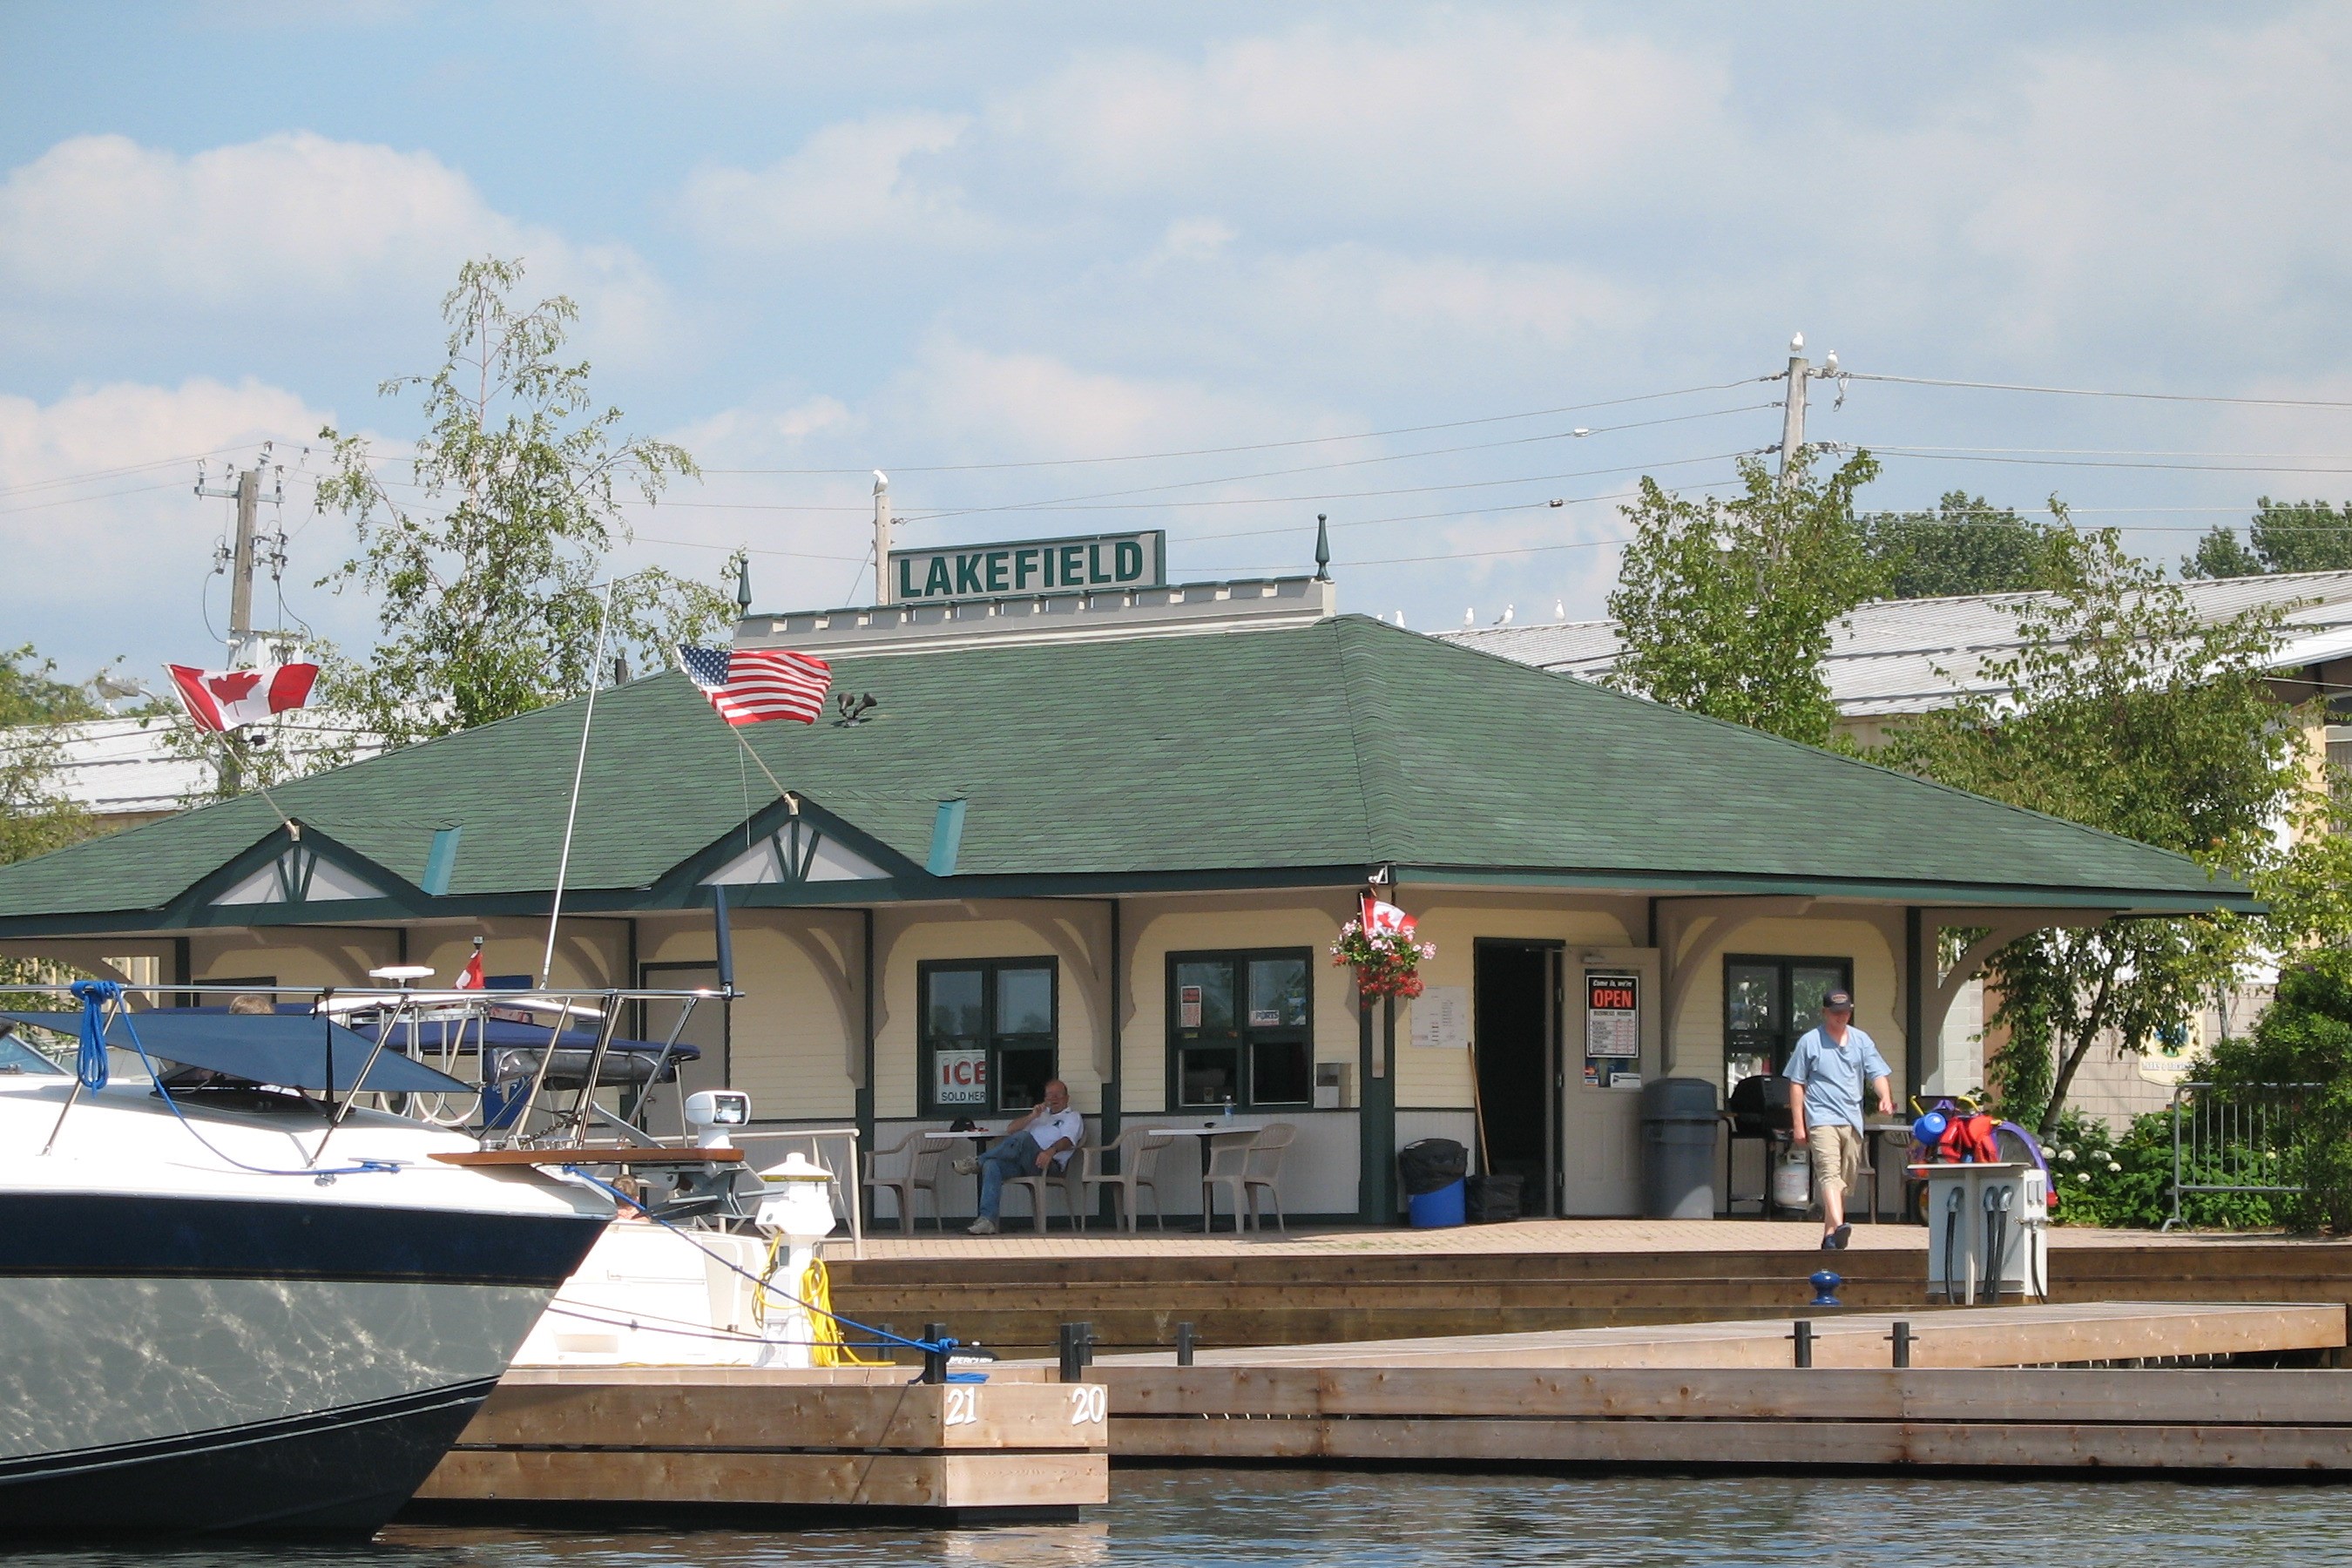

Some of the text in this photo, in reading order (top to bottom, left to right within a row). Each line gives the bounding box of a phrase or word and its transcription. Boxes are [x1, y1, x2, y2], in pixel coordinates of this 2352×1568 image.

[901, 542, 1143, 598] LAKEFIELD
[1594, 990, 1632, 1008] OPEN
[943, 1061, 987, 1085] ICE
[942, 1091, 986, 1101] SOLD HER
[945, 1386, 977, 1426] 21
[1071, 1386, 1107, 1425] 20
